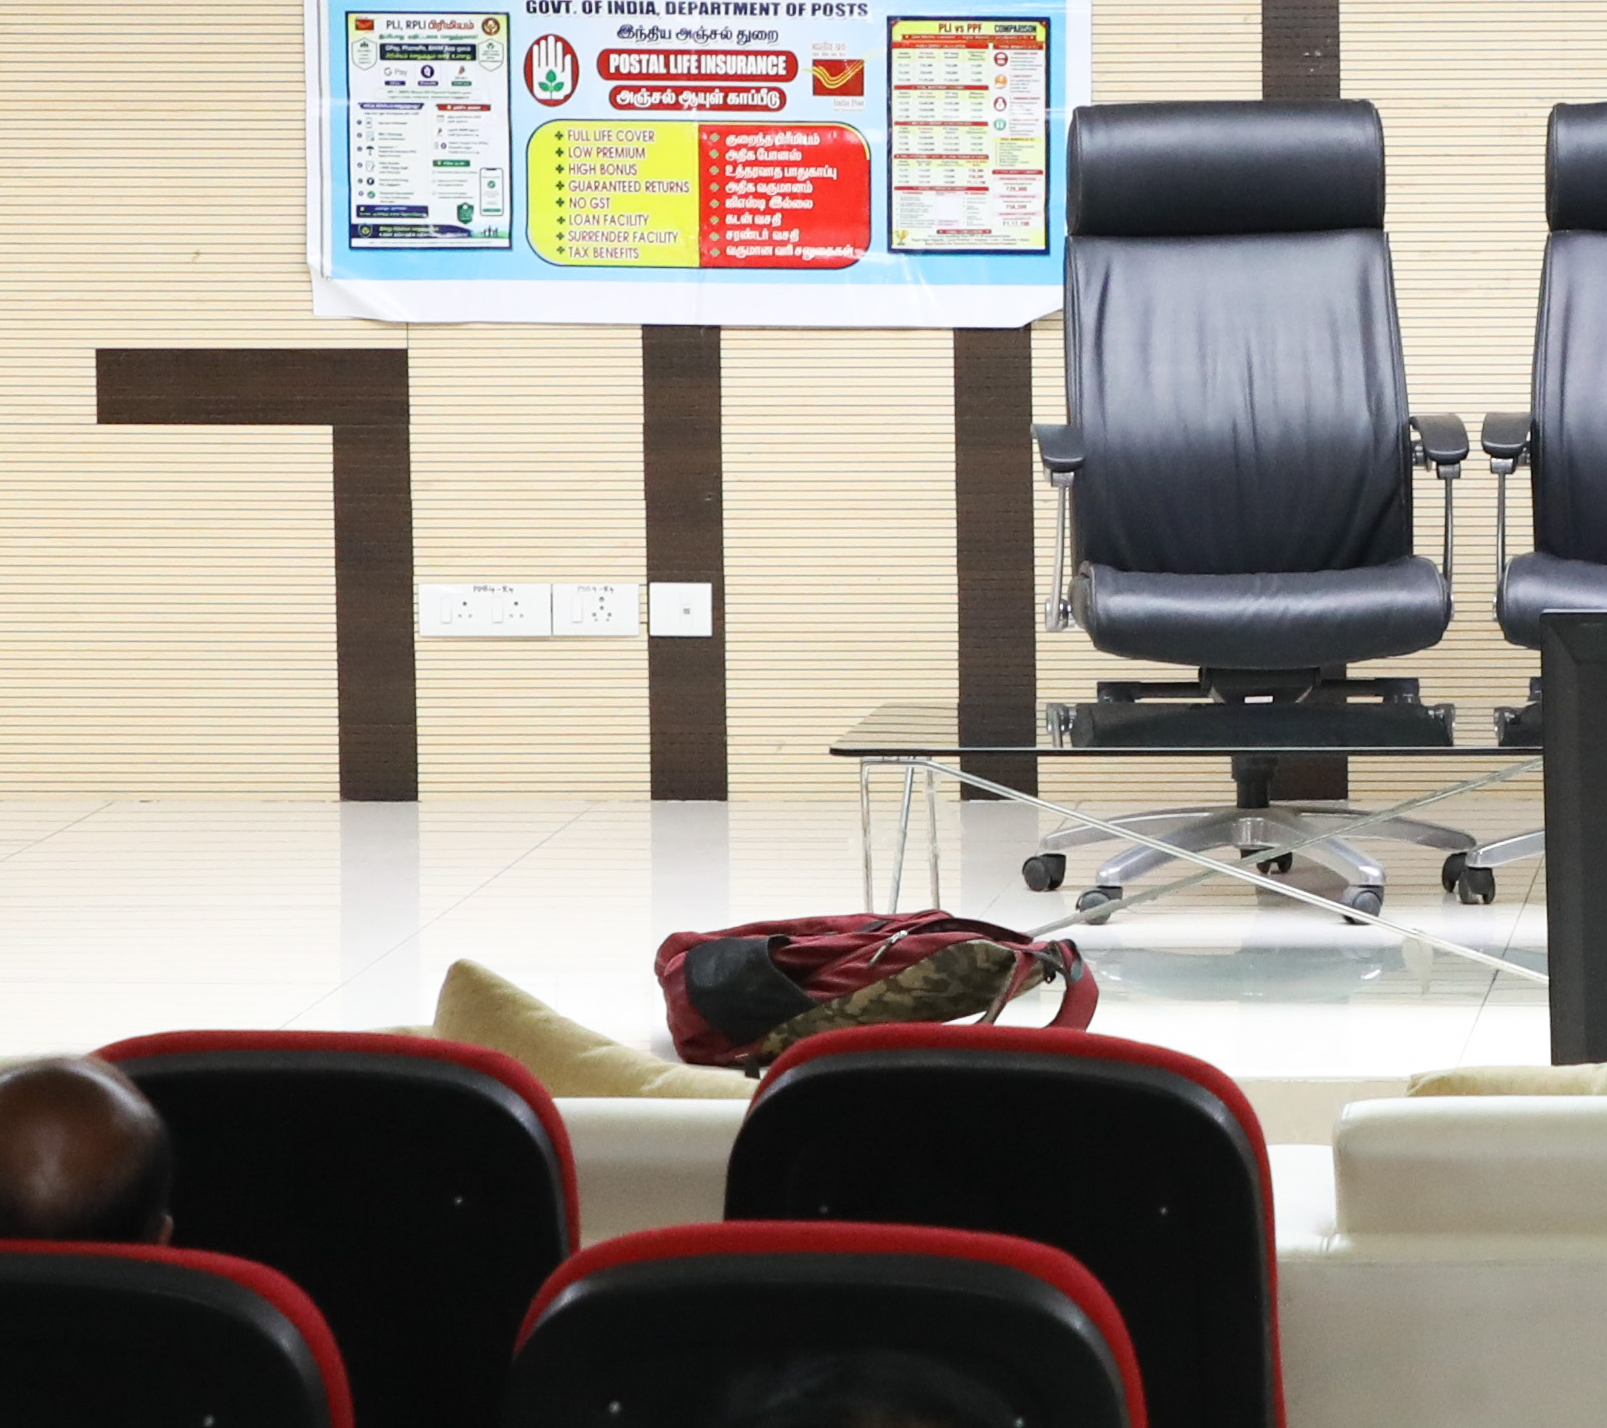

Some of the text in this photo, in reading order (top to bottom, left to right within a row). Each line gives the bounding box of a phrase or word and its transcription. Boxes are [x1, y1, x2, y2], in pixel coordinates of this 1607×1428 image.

[525, 0, 868, 16] GOVT. OF INDIA, DEPARTMENT OF POSTS
[386, 20, 403, 30] PLI,
[406, 20, 426, 30] RPLI
[938, 23, 982, 33] PLI vs PPF
[617, 24, 779, 45] இந்திய அஞ்சல் துறை
[609, 53, 787, 75] POSTAL LIFE INSURANCE
[616, 88, 780, 110] அஞ்சல் ஆயுள் காப்பீடு
[567, 130, 655, 142] FULL LIFE COVER
[568, 146, 645, 159] LOW PREMIUM
[725, 148, 755, 163] அதிக
[568, 163, 637, 175] HIGH BONUS
[568, 180, 690, 193] GUARANTEED RETURNS
[725, 180, 755, 194] அதிக
[569, 197, 611, 209] NO GST
[568, 214, 649, 226] LOAN FACILITY
[725, 212, 754, 224] கடன்
[568, 231, 679, 243] SURRENDER FACILITY
[568, 247, 639, 259] TAX BENEFITS
